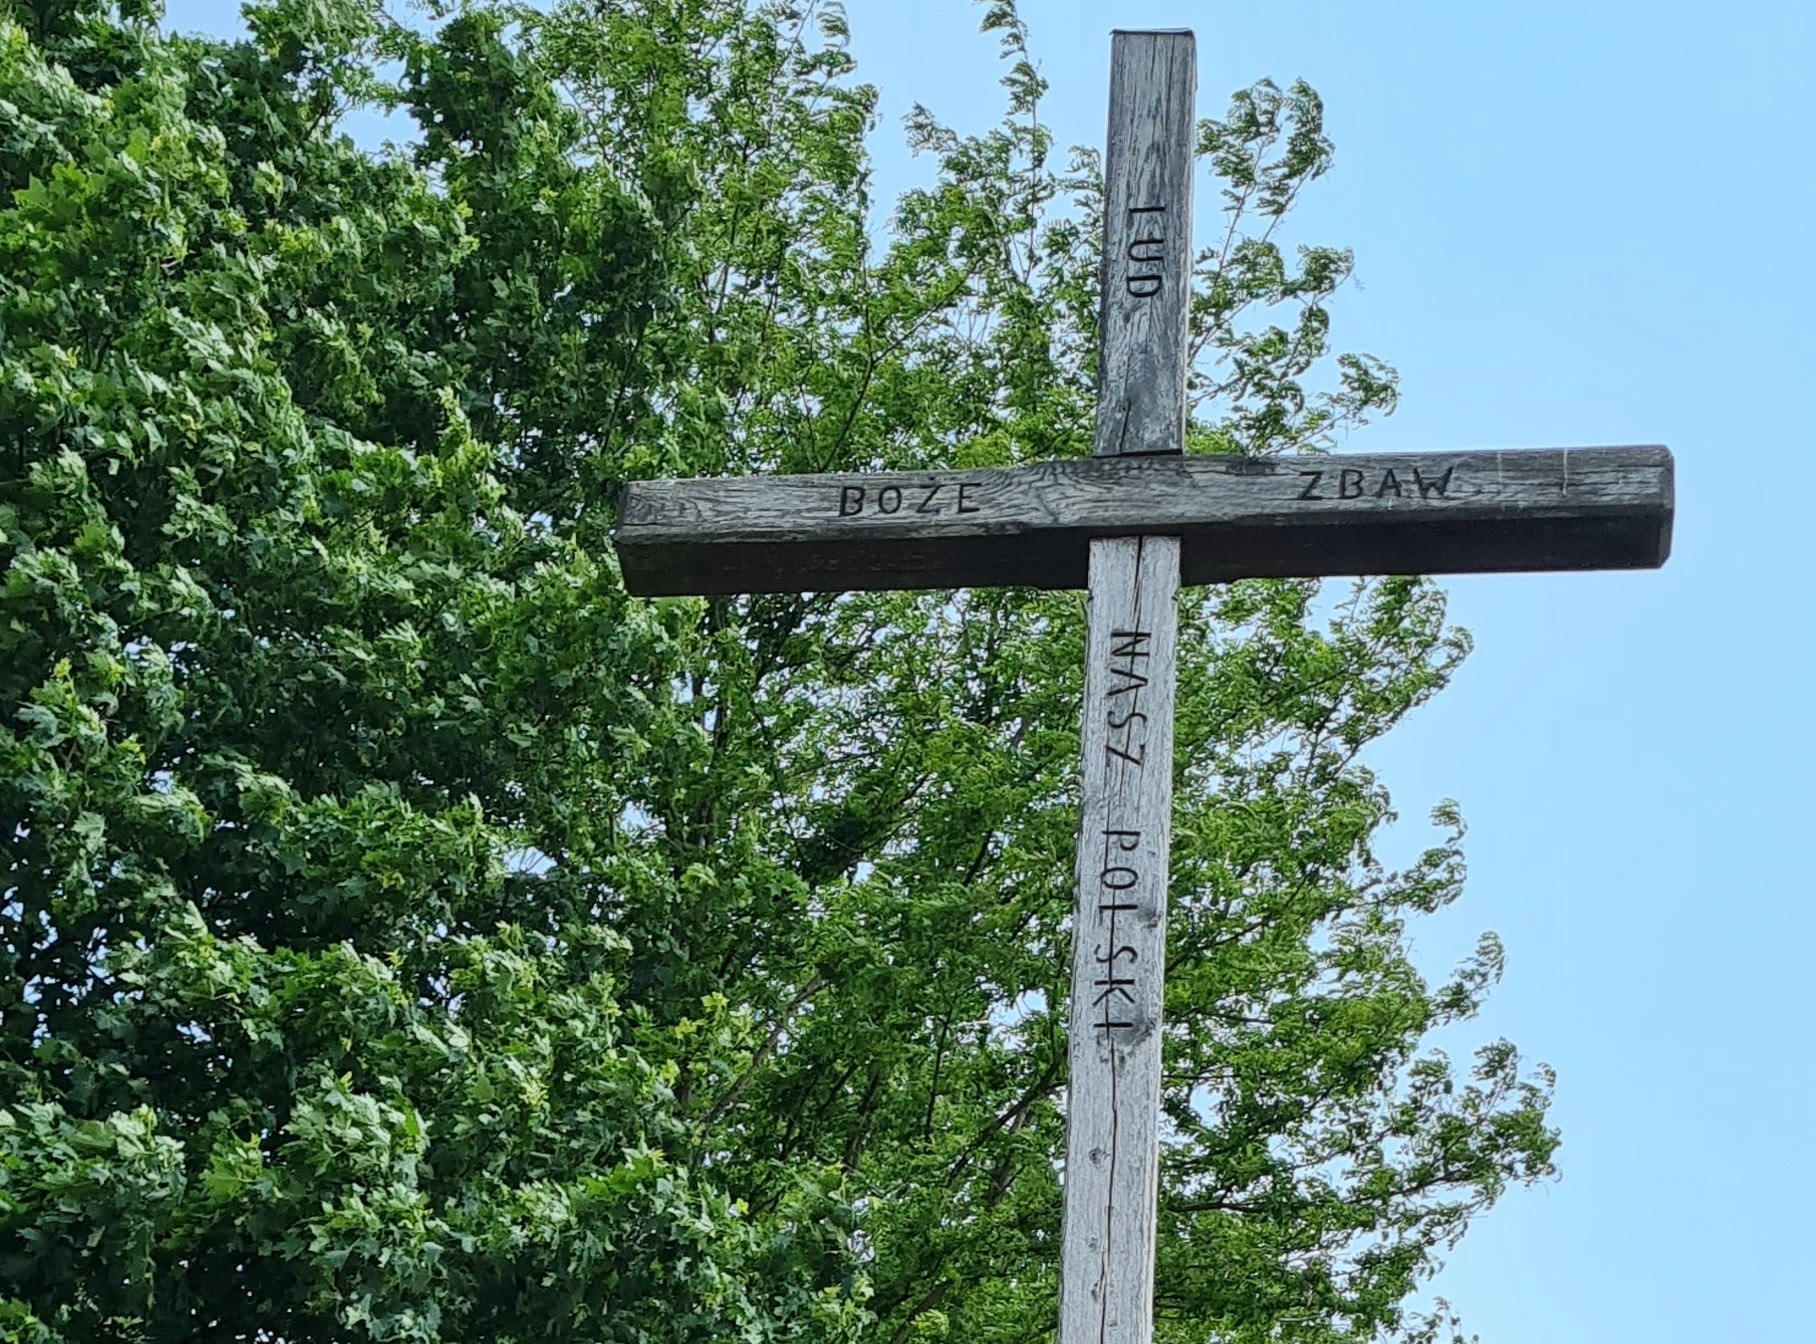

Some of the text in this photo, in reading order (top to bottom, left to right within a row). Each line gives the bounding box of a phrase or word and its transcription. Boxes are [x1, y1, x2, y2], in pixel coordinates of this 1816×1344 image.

[1126, 206, 1166, 298] LUD
[1297, 466, 1454, 500] ZBAW
[1093, 630, 1152, 1030] NASZ POLSKI
